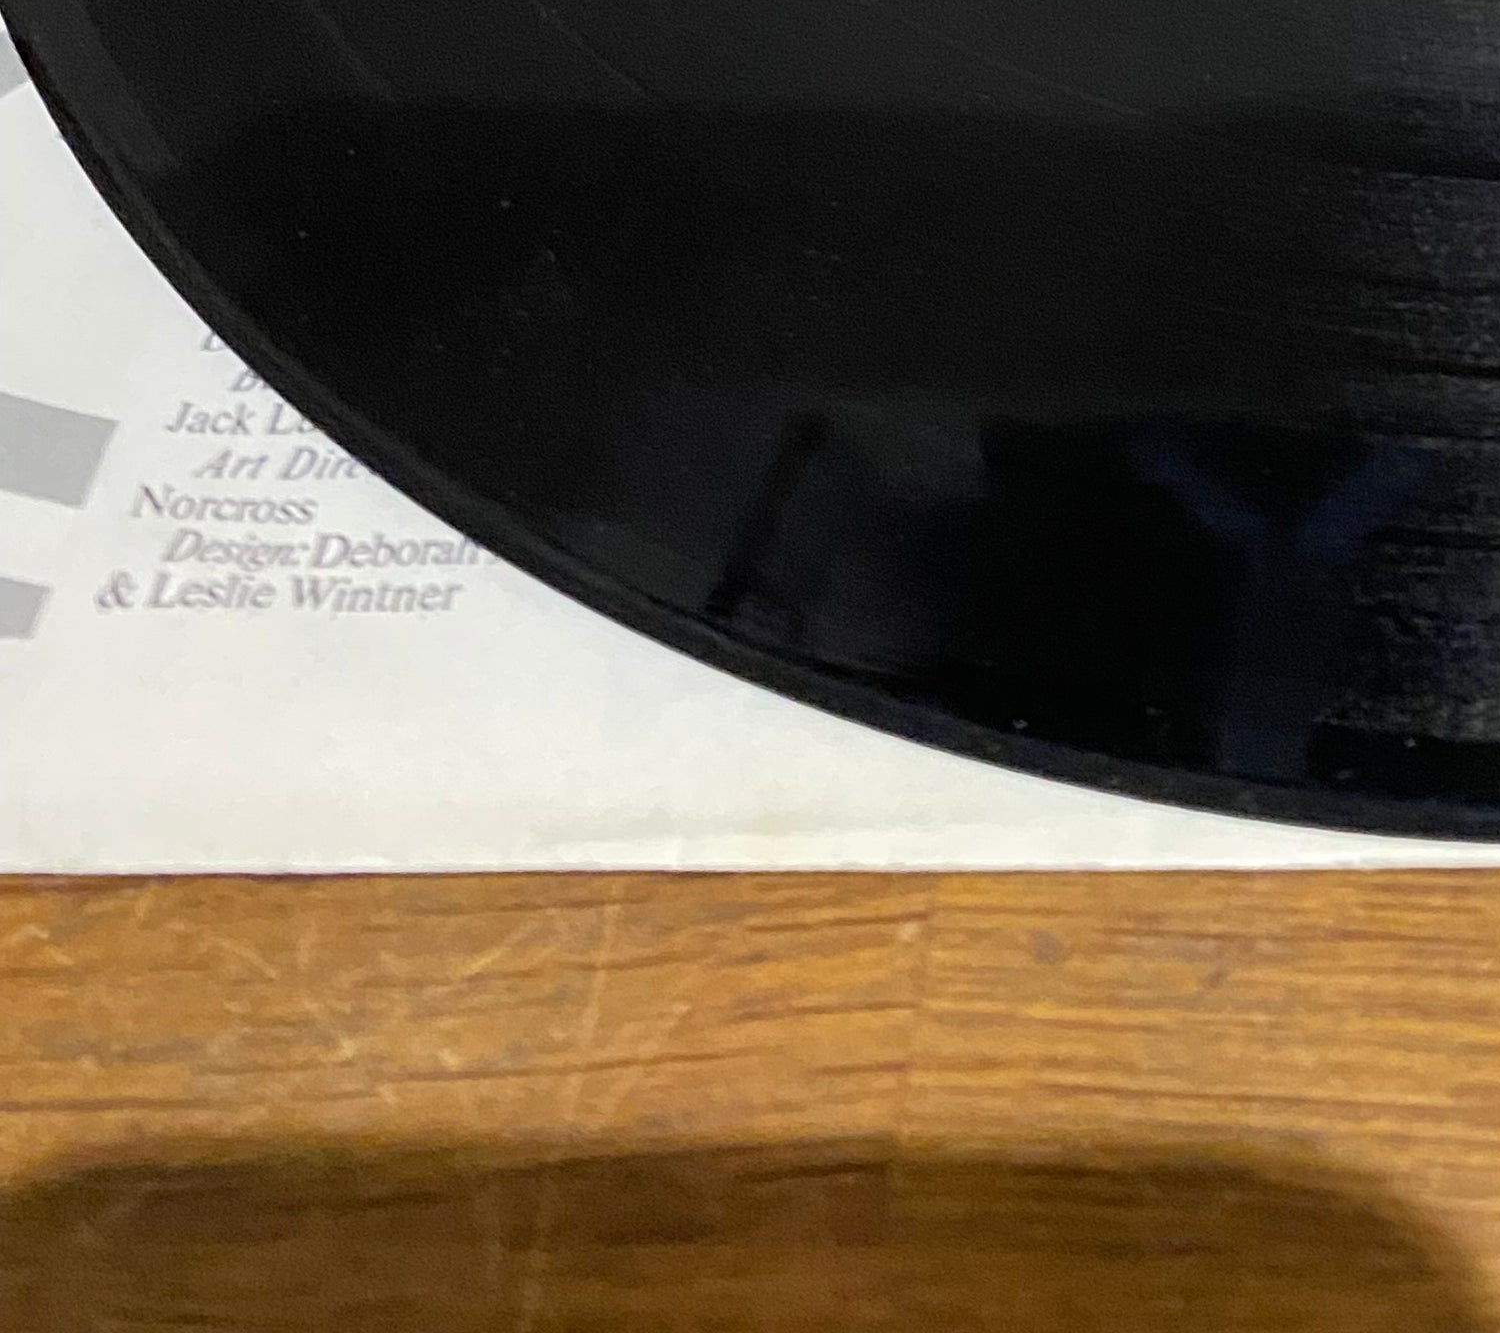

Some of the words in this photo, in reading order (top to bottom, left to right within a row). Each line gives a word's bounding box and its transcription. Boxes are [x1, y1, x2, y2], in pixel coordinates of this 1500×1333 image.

[166, 401, 254, 435] Jack
[194, 450, 268, 479] Art
[130, 484, 318, 524] Norcross
[96, 571, 137, 610] &
[149, 573, 276, 610] Leslie
[292, 577, 464, 614] Wintner
